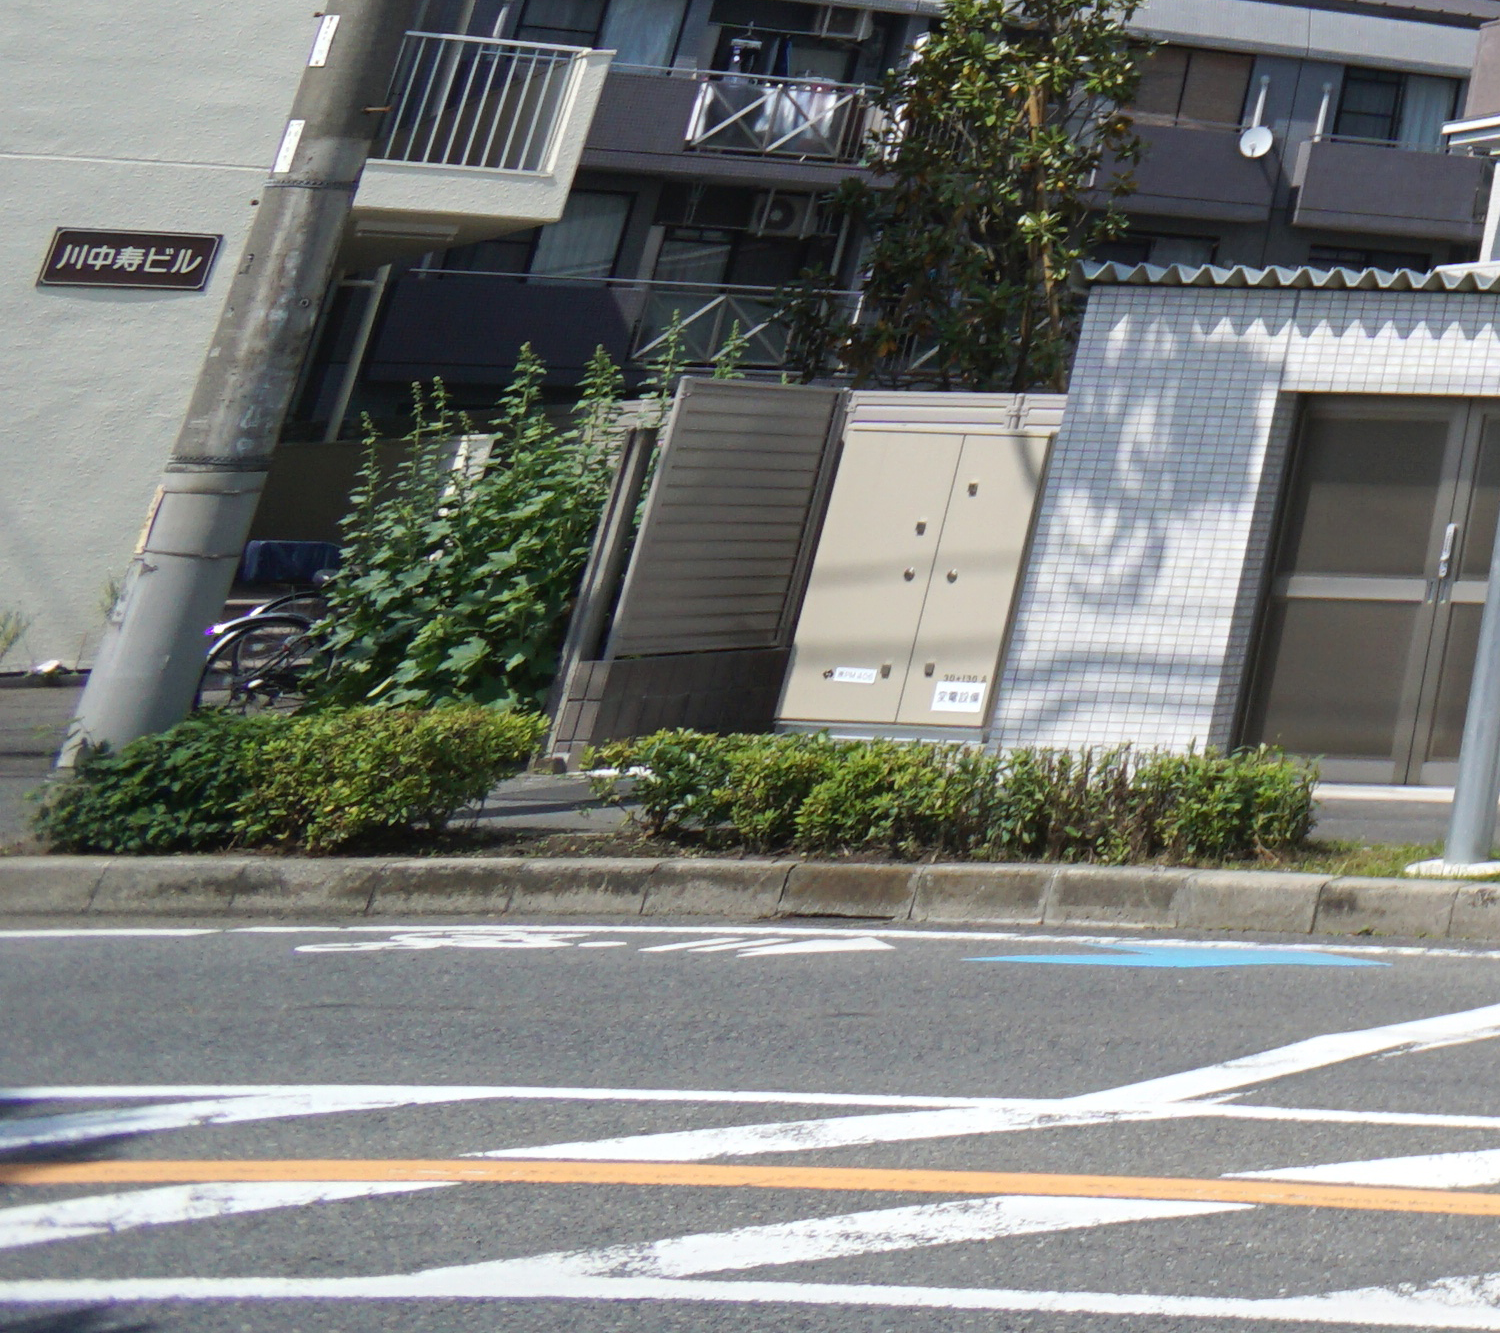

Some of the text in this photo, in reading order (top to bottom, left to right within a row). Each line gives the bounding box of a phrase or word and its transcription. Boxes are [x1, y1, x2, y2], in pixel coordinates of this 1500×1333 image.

[55, 243, 203, 274] 川中寿ビル
